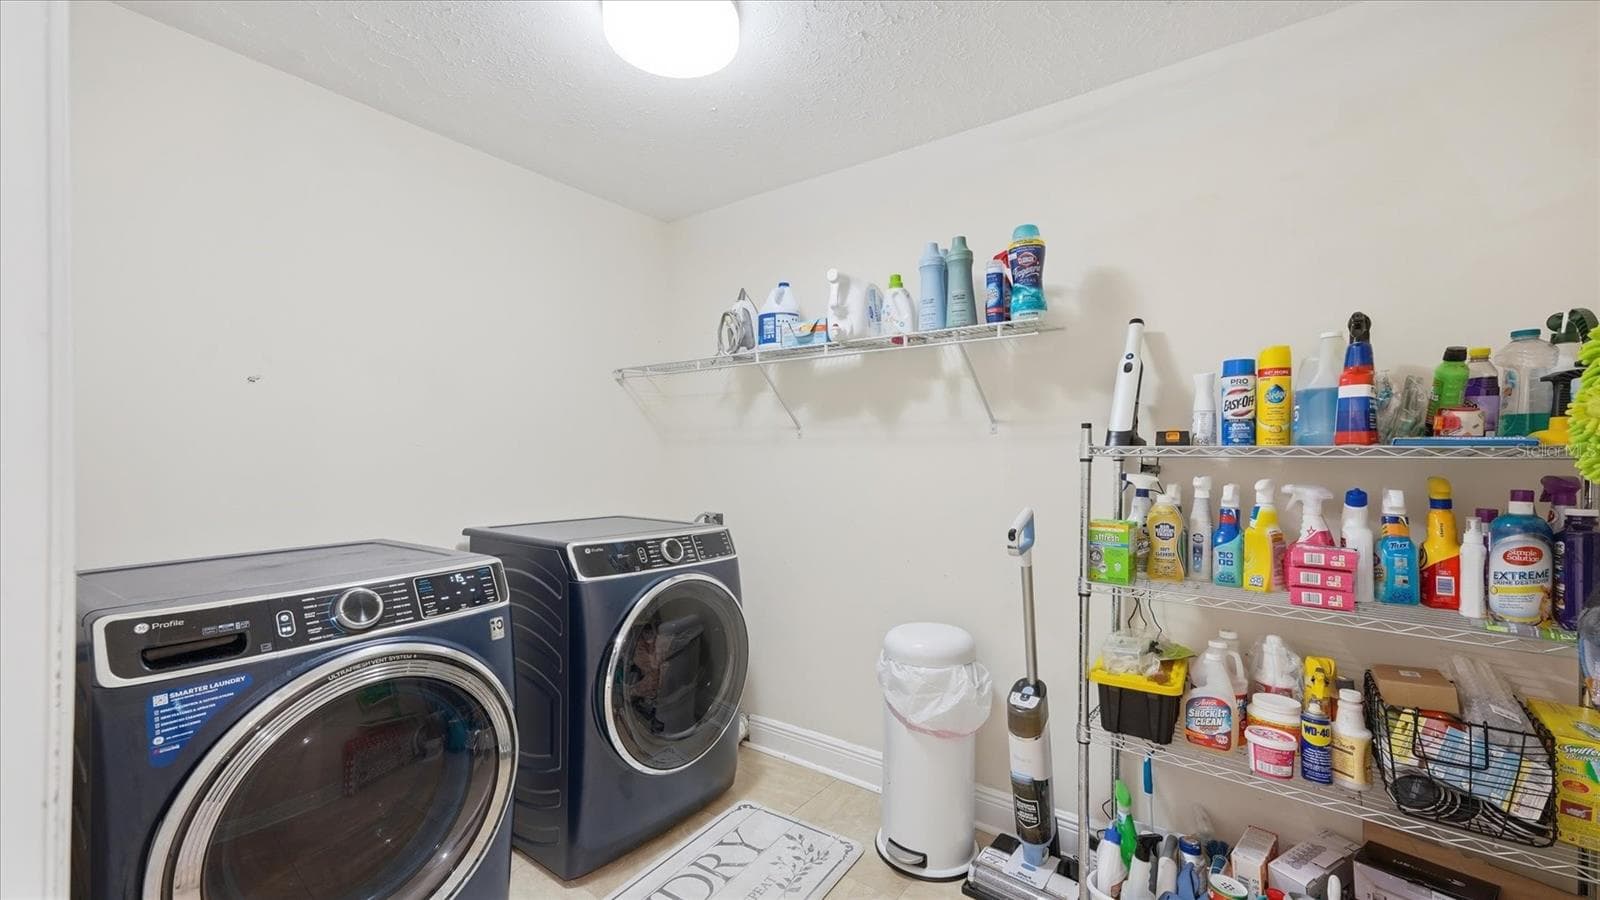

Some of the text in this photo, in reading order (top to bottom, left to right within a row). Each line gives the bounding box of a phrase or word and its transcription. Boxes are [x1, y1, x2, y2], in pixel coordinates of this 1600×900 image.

[1508, 548, 1537, 556] Simple
[1493, 568, 1550, 580] EXTREME
[151, 619, 185, 630] Profile
[371, 657, 388, 666] VENT
[169, 685, 208, 699] SMARTER
[209, 676, 246, 690] LAUNDRY
[1195, 717, 1223, 726] CLEAN
[1303, 724, 1330, 738] WD-40
[645, 828, 765, 900] DRY
